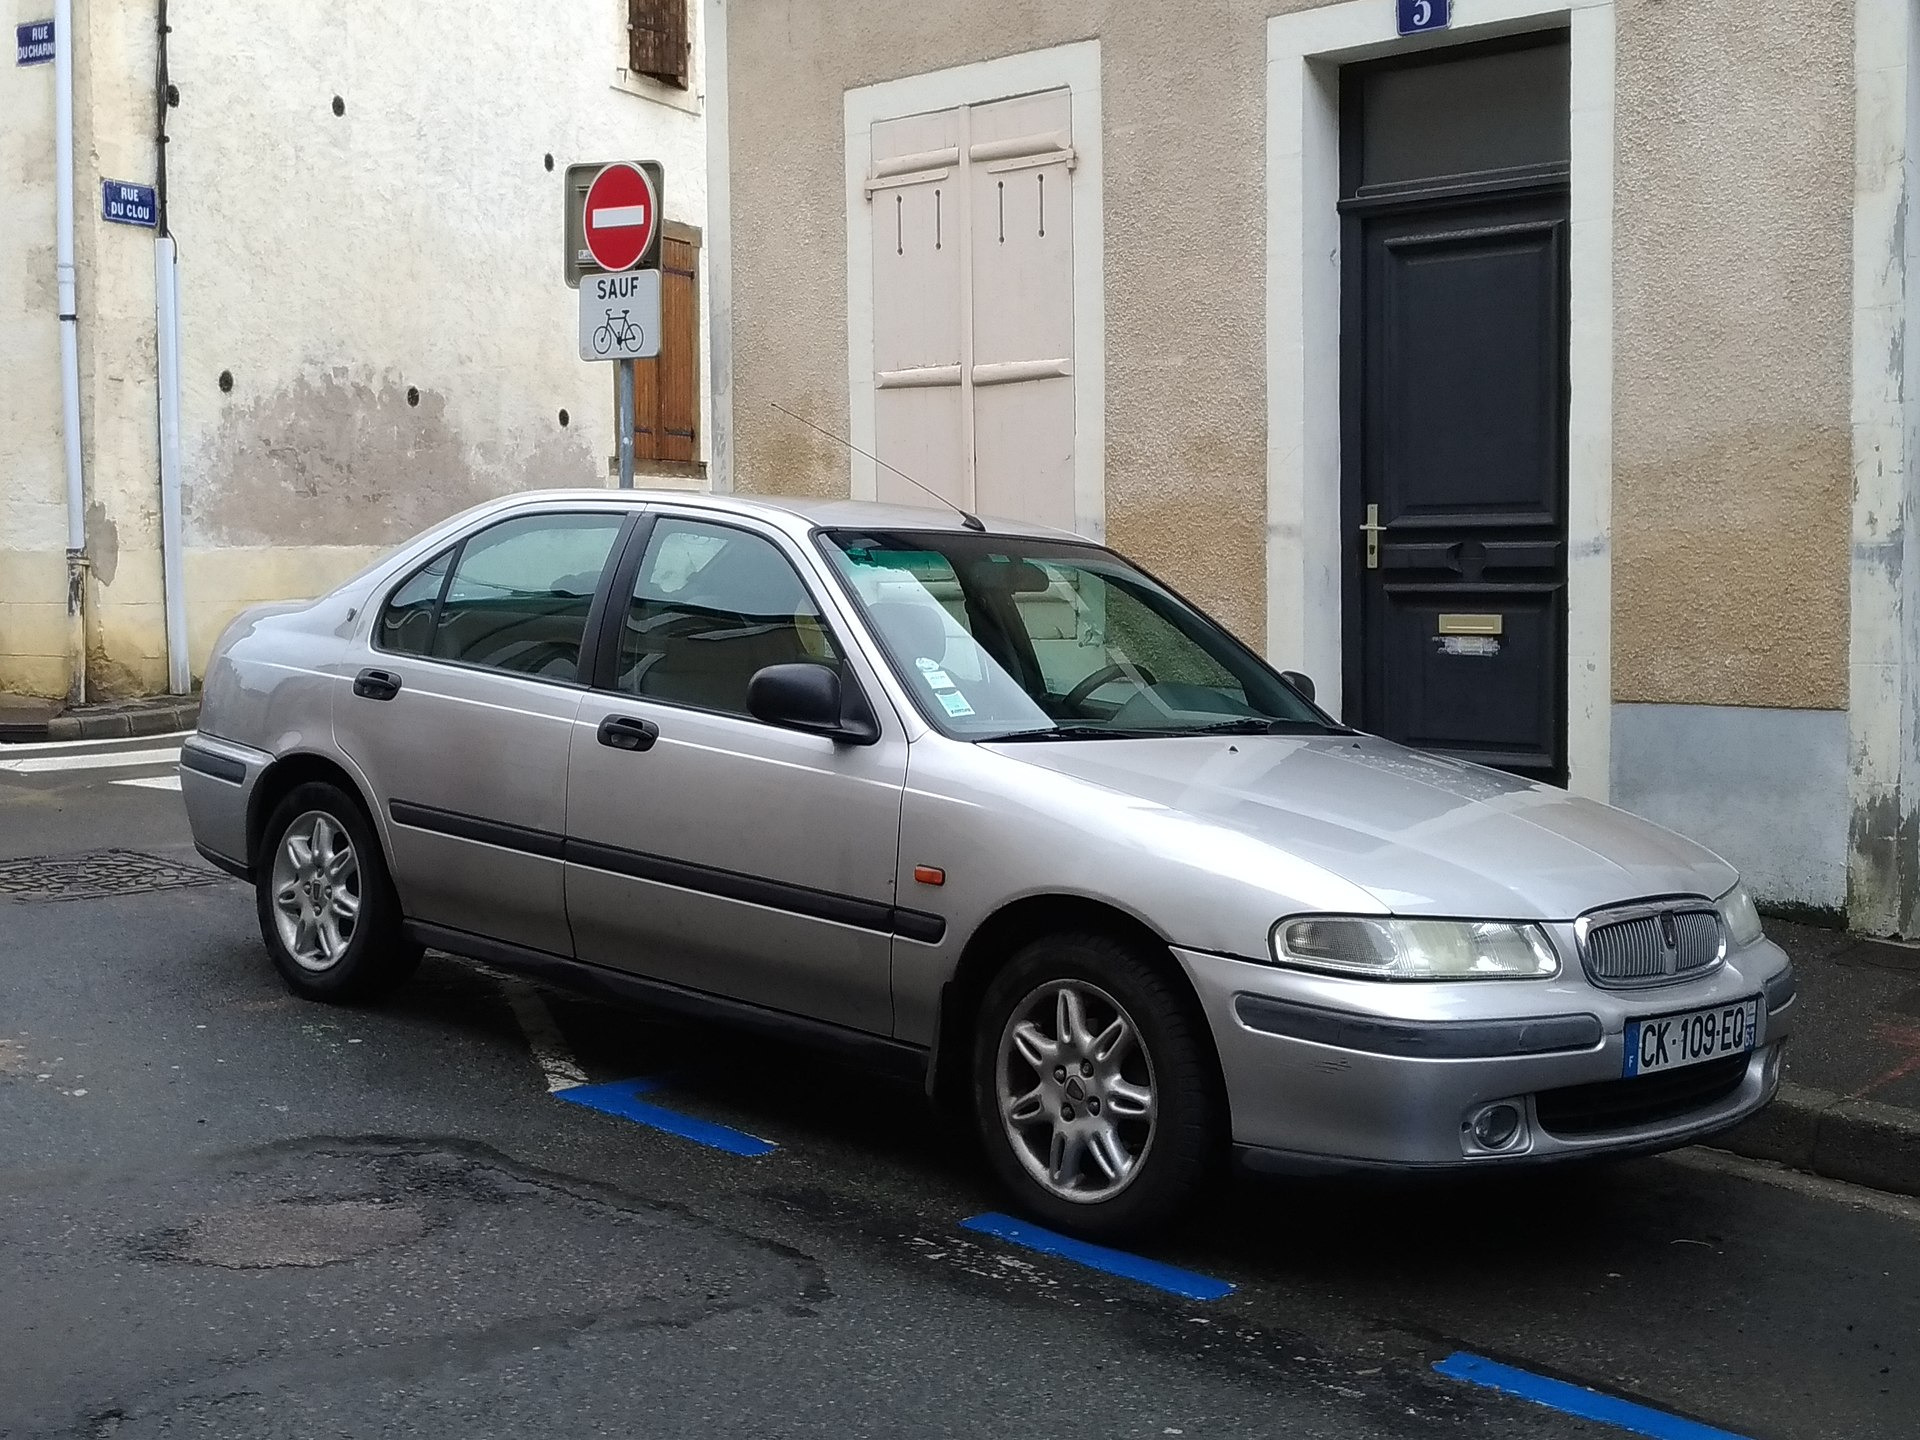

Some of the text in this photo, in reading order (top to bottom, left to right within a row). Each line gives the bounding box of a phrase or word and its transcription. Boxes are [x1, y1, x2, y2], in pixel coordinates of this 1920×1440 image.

[32, 26, 49, 41] RUE
[18, 46, 28, 60] DU
[121, 187, 139, 202] RUE
[111, 201, 150, 220] DU CLOU
[597, 276, 639, 300] SAUF
[1628, 1055, 1635, 1068] F
